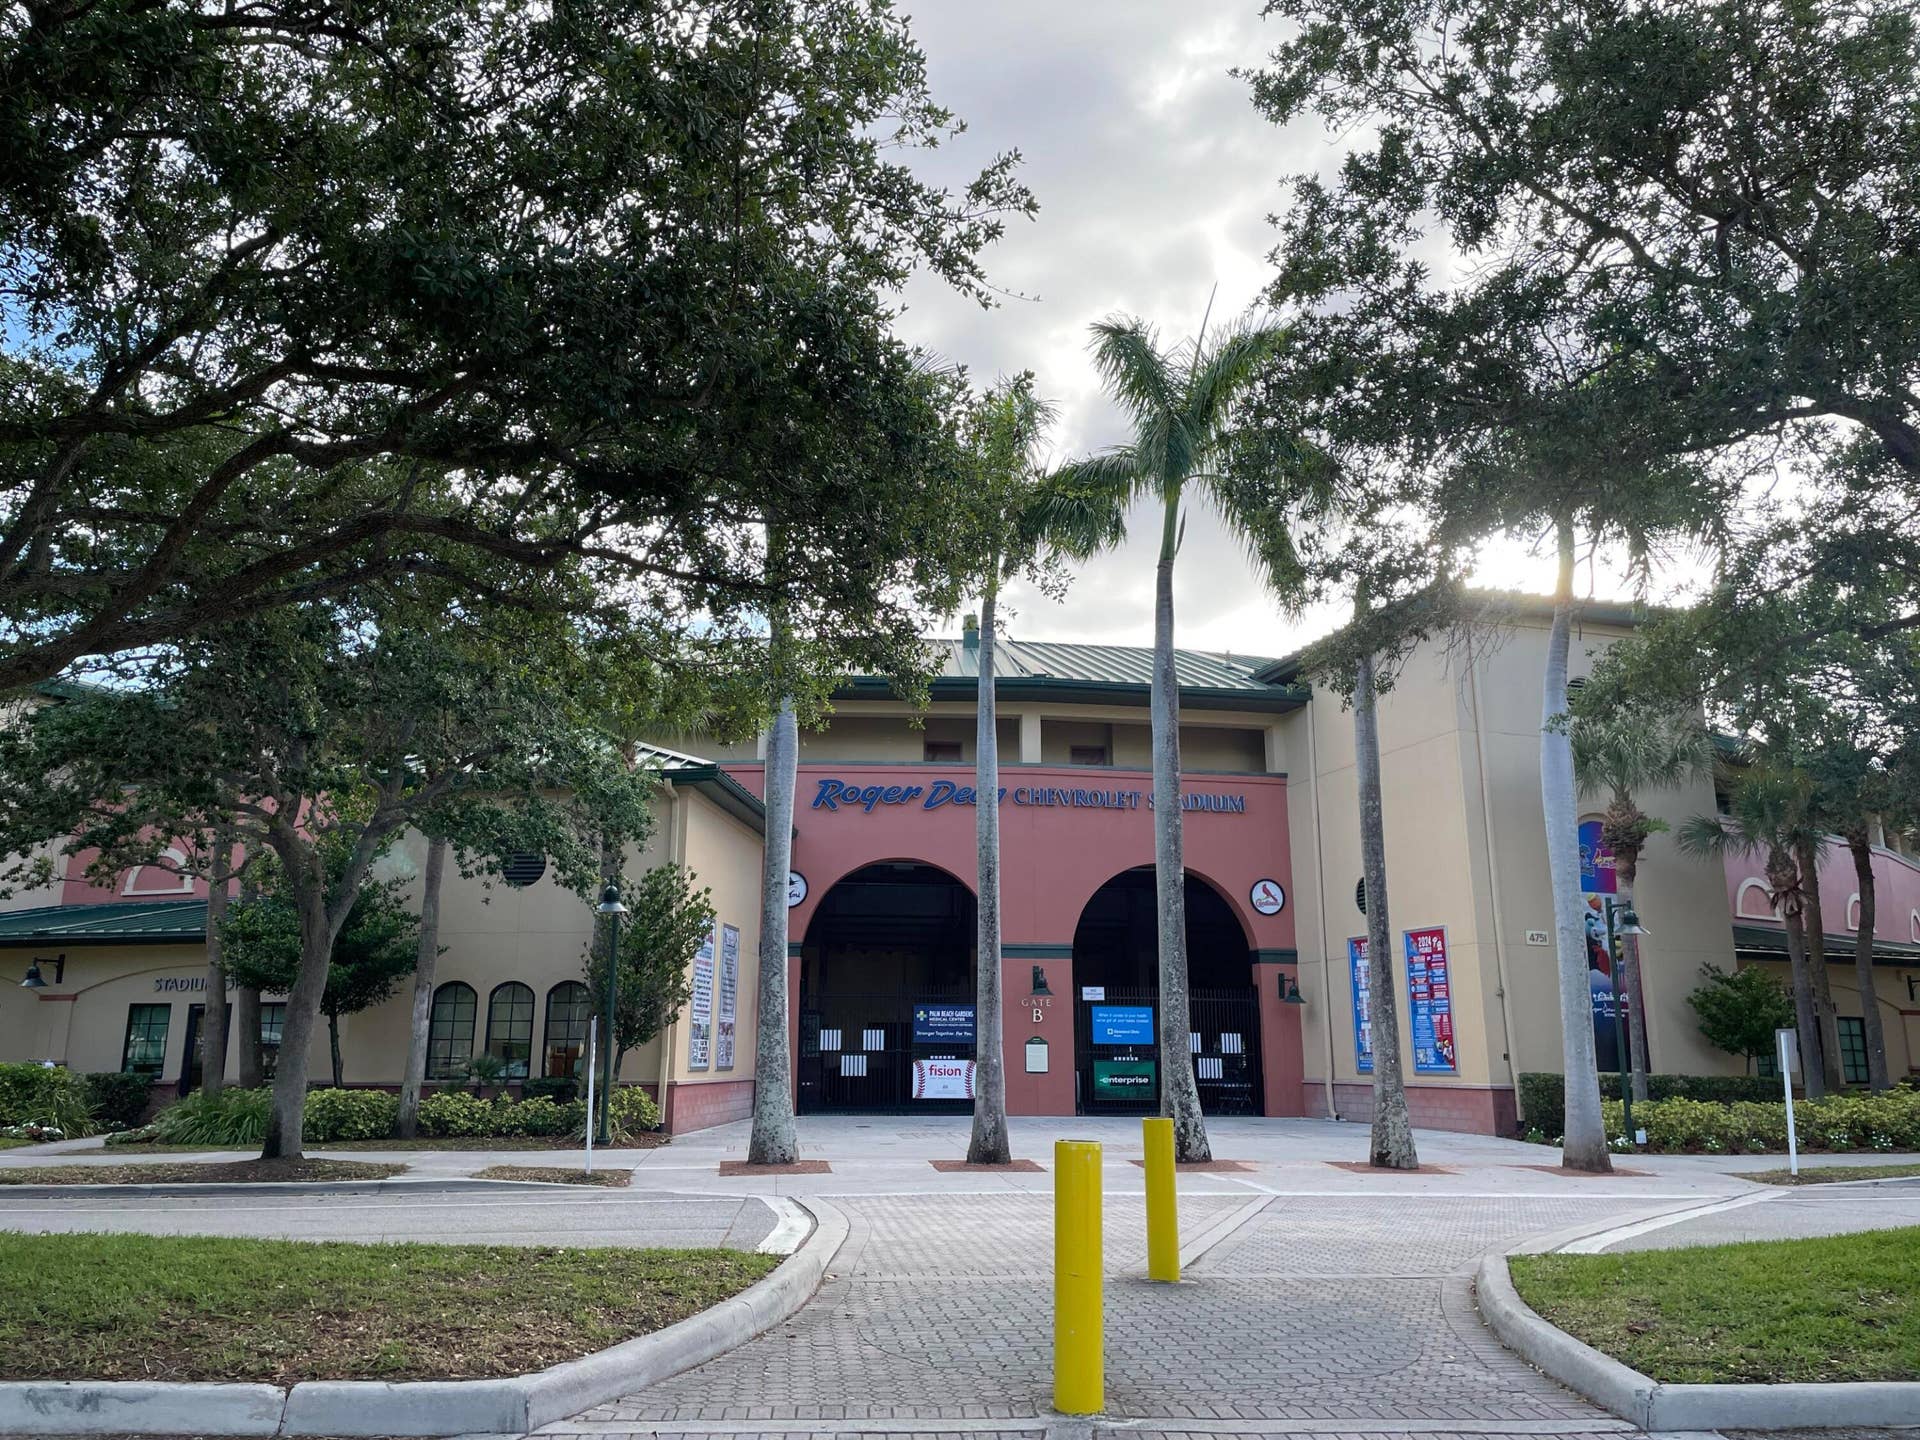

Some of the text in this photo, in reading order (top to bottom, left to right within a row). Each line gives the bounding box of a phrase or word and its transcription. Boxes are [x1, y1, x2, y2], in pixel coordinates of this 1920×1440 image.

[812, 779, 924, 813] Roger
[1013, 787, 1142, 810] CHEVROLET
[1148, 793, 1245, 812] SADIUM
[1418, 936, 1432, 947] 2024
[1529, 932, 1548, 943] 4751
[154, 977, 208, 992] STADIU
[1021, 999, 1052, 1007] GATE
[1033, 1008, 1044, 1023] B
[929, 1064, 962, 1076] fision
[1102, 1076, 1149, 1085] enterprise
